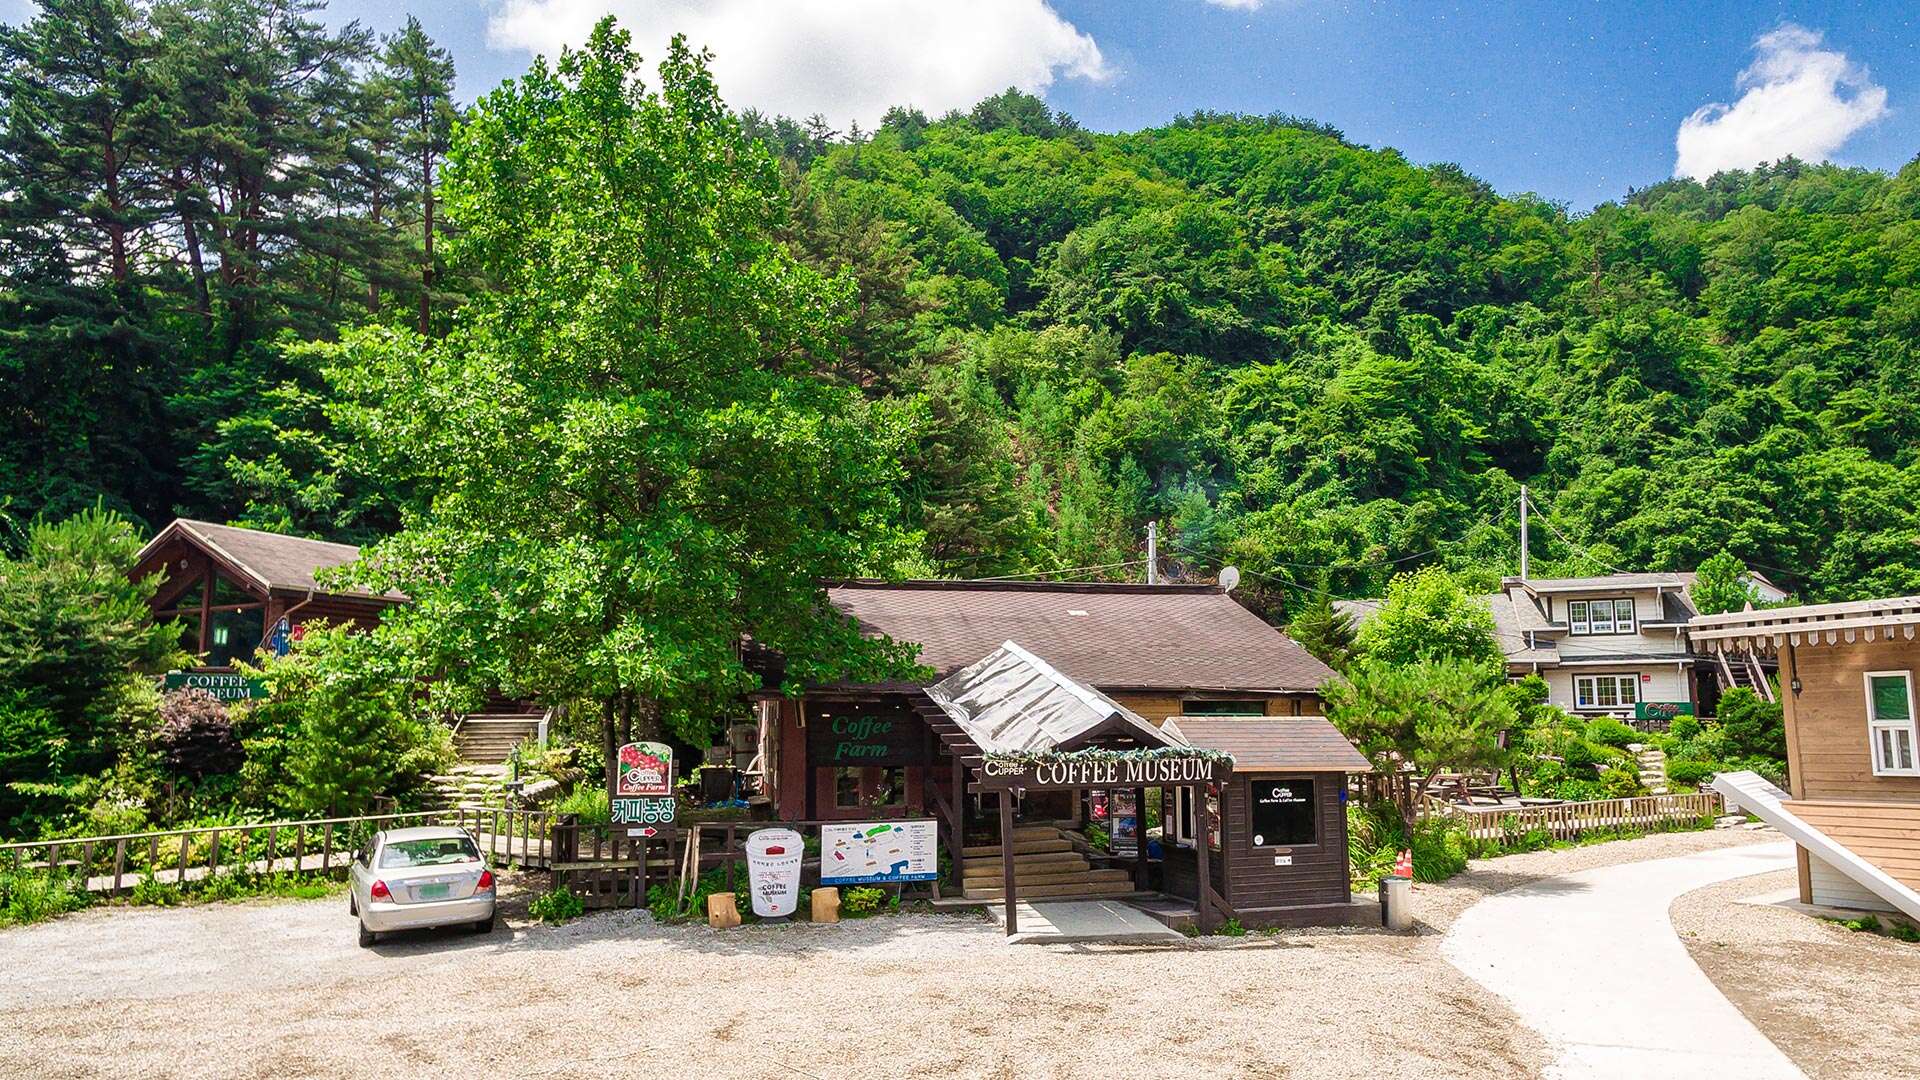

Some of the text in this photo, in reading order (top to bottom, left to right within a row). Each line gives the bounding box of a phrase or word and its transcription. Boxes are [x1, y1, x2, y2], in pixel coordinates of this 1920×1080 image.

[187, 676, 248, 687] COFFEE
[832, 715, 892, 740] Coffee
[834, 741, 888, 760] Farm
[1037, 758, 1213, 784] COFFEE MUSEUM
[623, 784, 645, 792] Coffee
[611, 798, 675, 823] 커피농장
